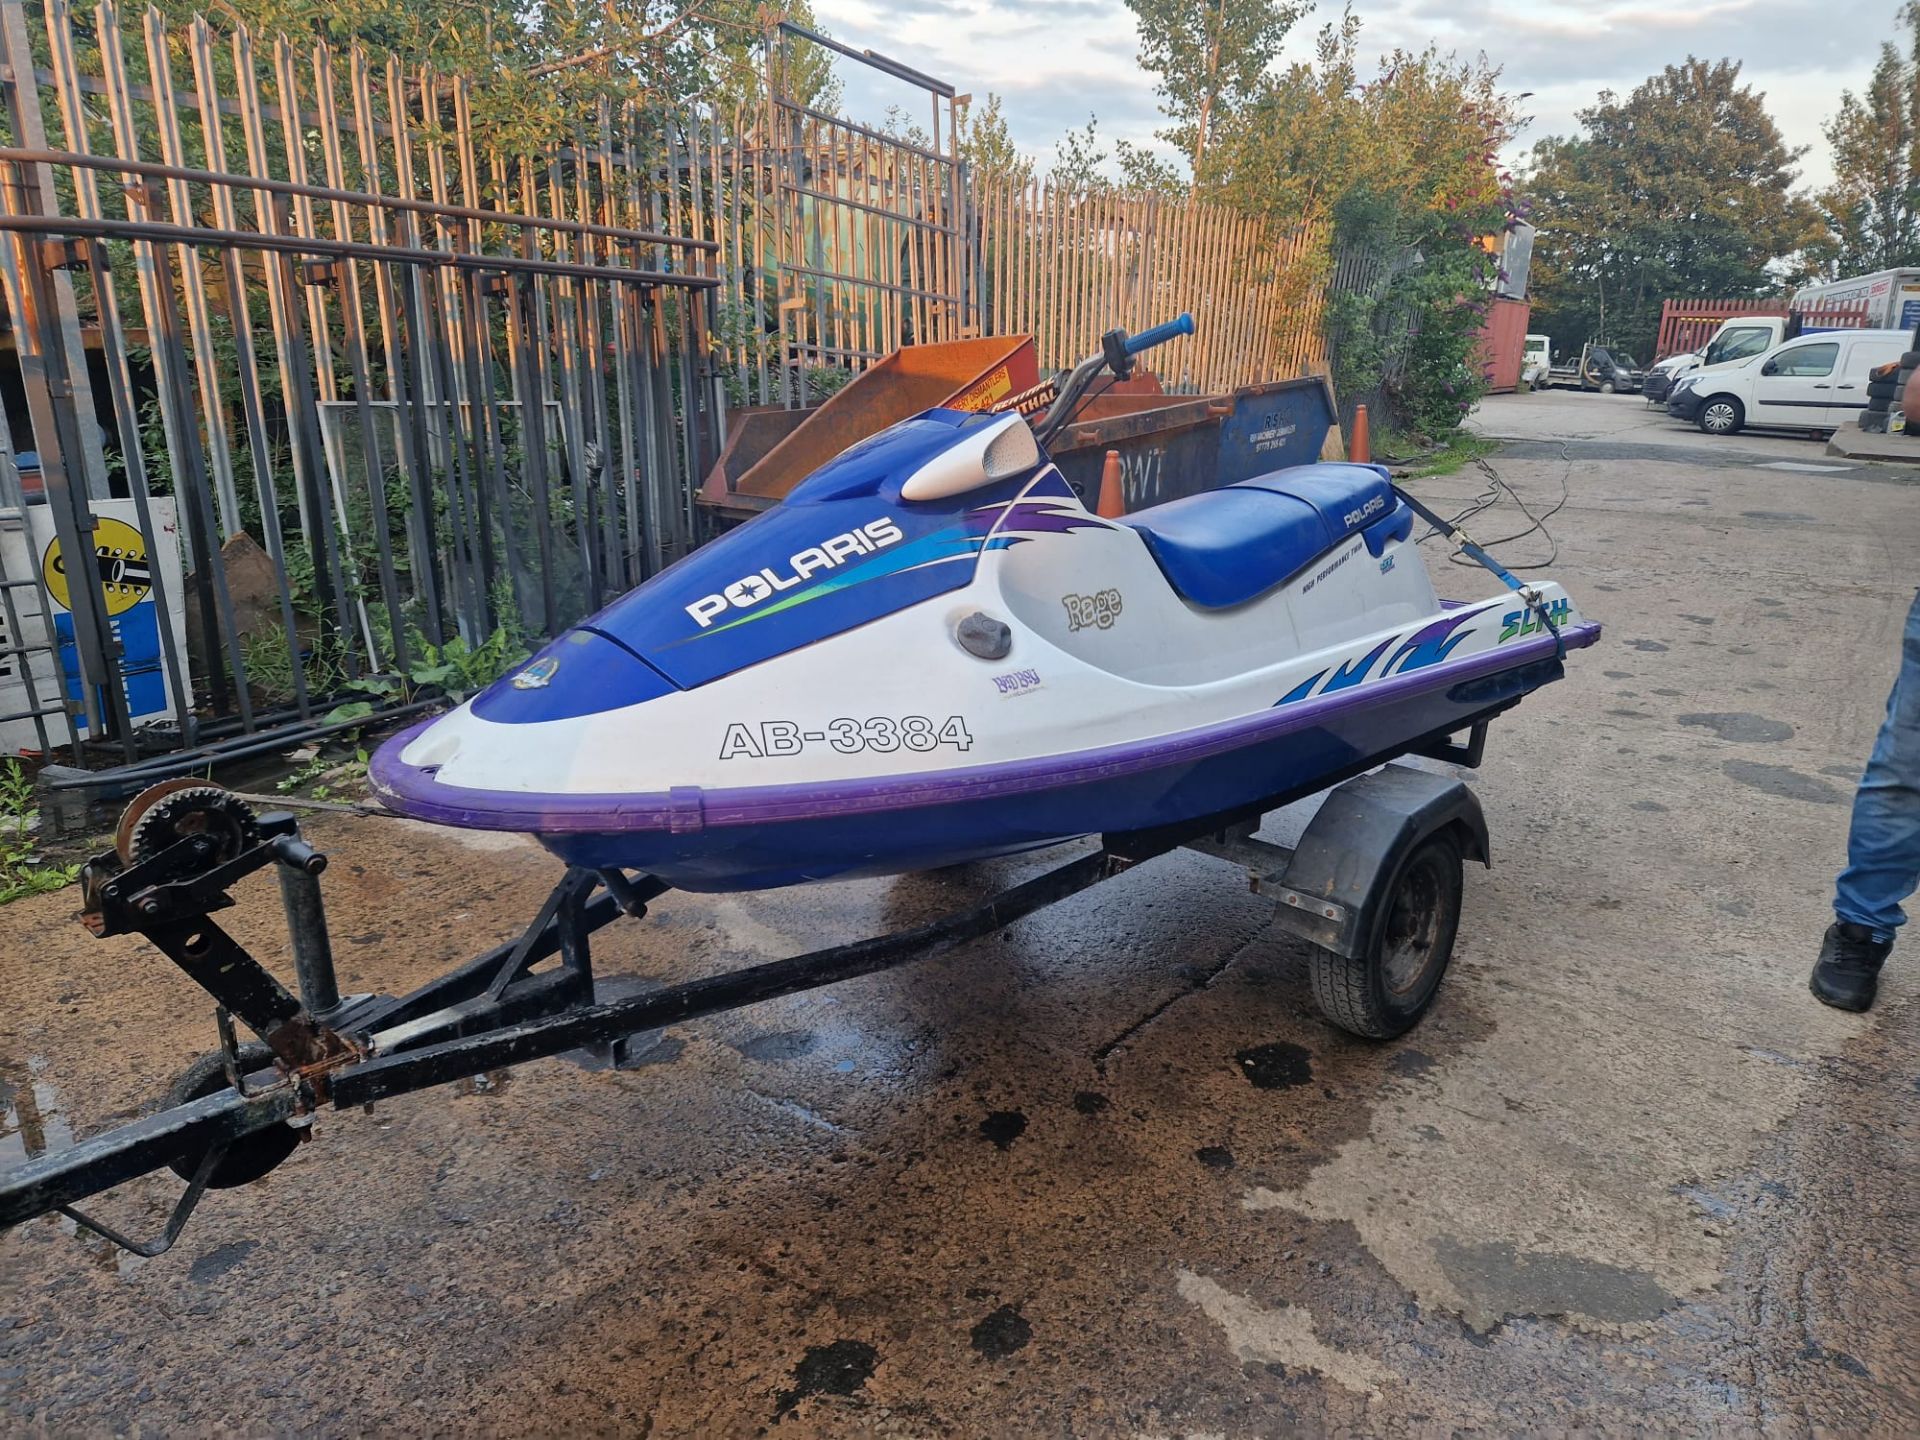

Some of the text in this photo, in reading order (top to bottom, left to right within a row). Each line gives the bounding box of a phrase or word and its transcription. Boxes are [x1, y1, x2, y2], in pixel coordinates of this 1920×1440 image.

[969, 368, 1006, 402] DISMANTLERS
[1015, 388, 1058, 415] THAL
[1343, 495, 1385, 528] POLARIS
[684, 516, 903, 628] POLARIS
[1062, 588, 1123, 632] Rage
[719, 716, 973, 760] AB-3384
